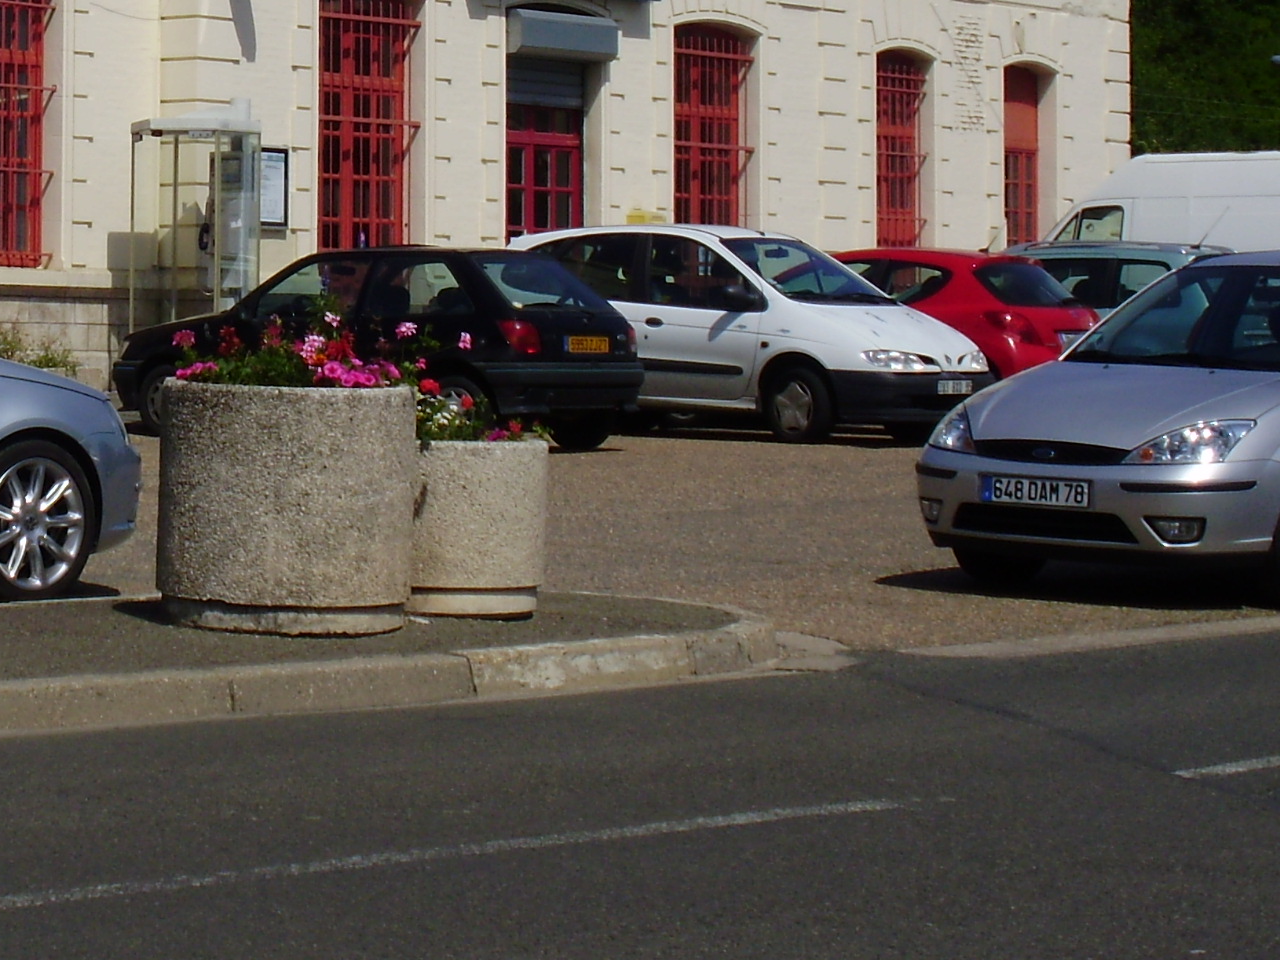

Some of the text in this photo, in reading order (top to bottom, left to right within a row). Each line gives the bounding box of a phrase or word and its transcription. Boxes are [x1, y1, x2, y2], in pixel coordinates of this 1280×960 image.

[993, 479, 1085, 505] 648 DAM 78
